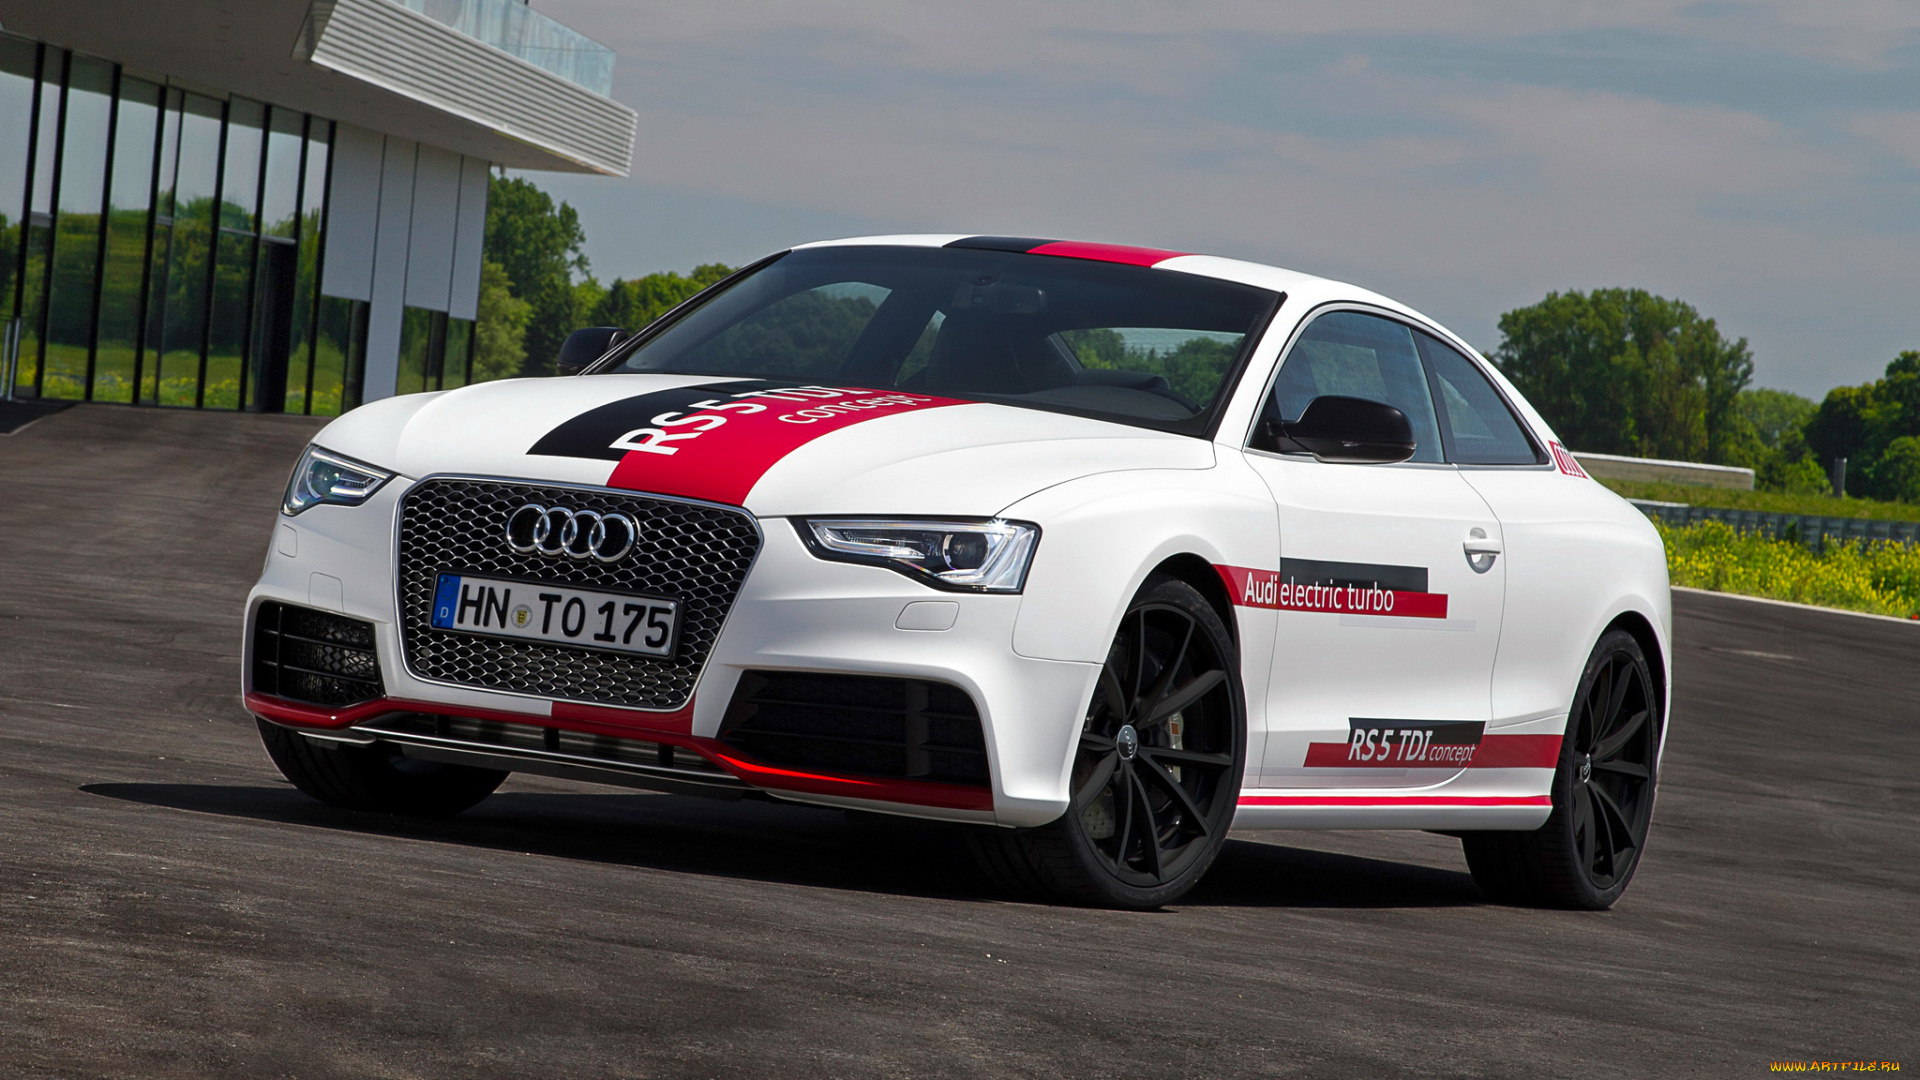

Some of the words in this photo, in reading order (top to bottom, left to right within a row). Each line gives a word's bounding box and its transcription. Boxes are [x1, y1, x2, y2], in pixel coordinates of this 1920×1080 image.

[608, 411, 728, 456] RS
[688, 399, 768, 415] 5
[730, 385, 874, 402] TDI
[778, 394, 932, 424] concept
[1244, 571, 1278, 604] Audi
[1280, 576, 1343, 609] electric
[1347, 581, 1394, 612] turbo
[440, 606, 449, 619] D
[457, 584, 511, 629] HN
[593, 600, 673, 648] 175
[1348, 729, 1379, 761] RS
[1375, 729, 1394, 761] 5
[1396, 730, 1434, 761] TDI
[1429, 743, 1476, 765] concept
